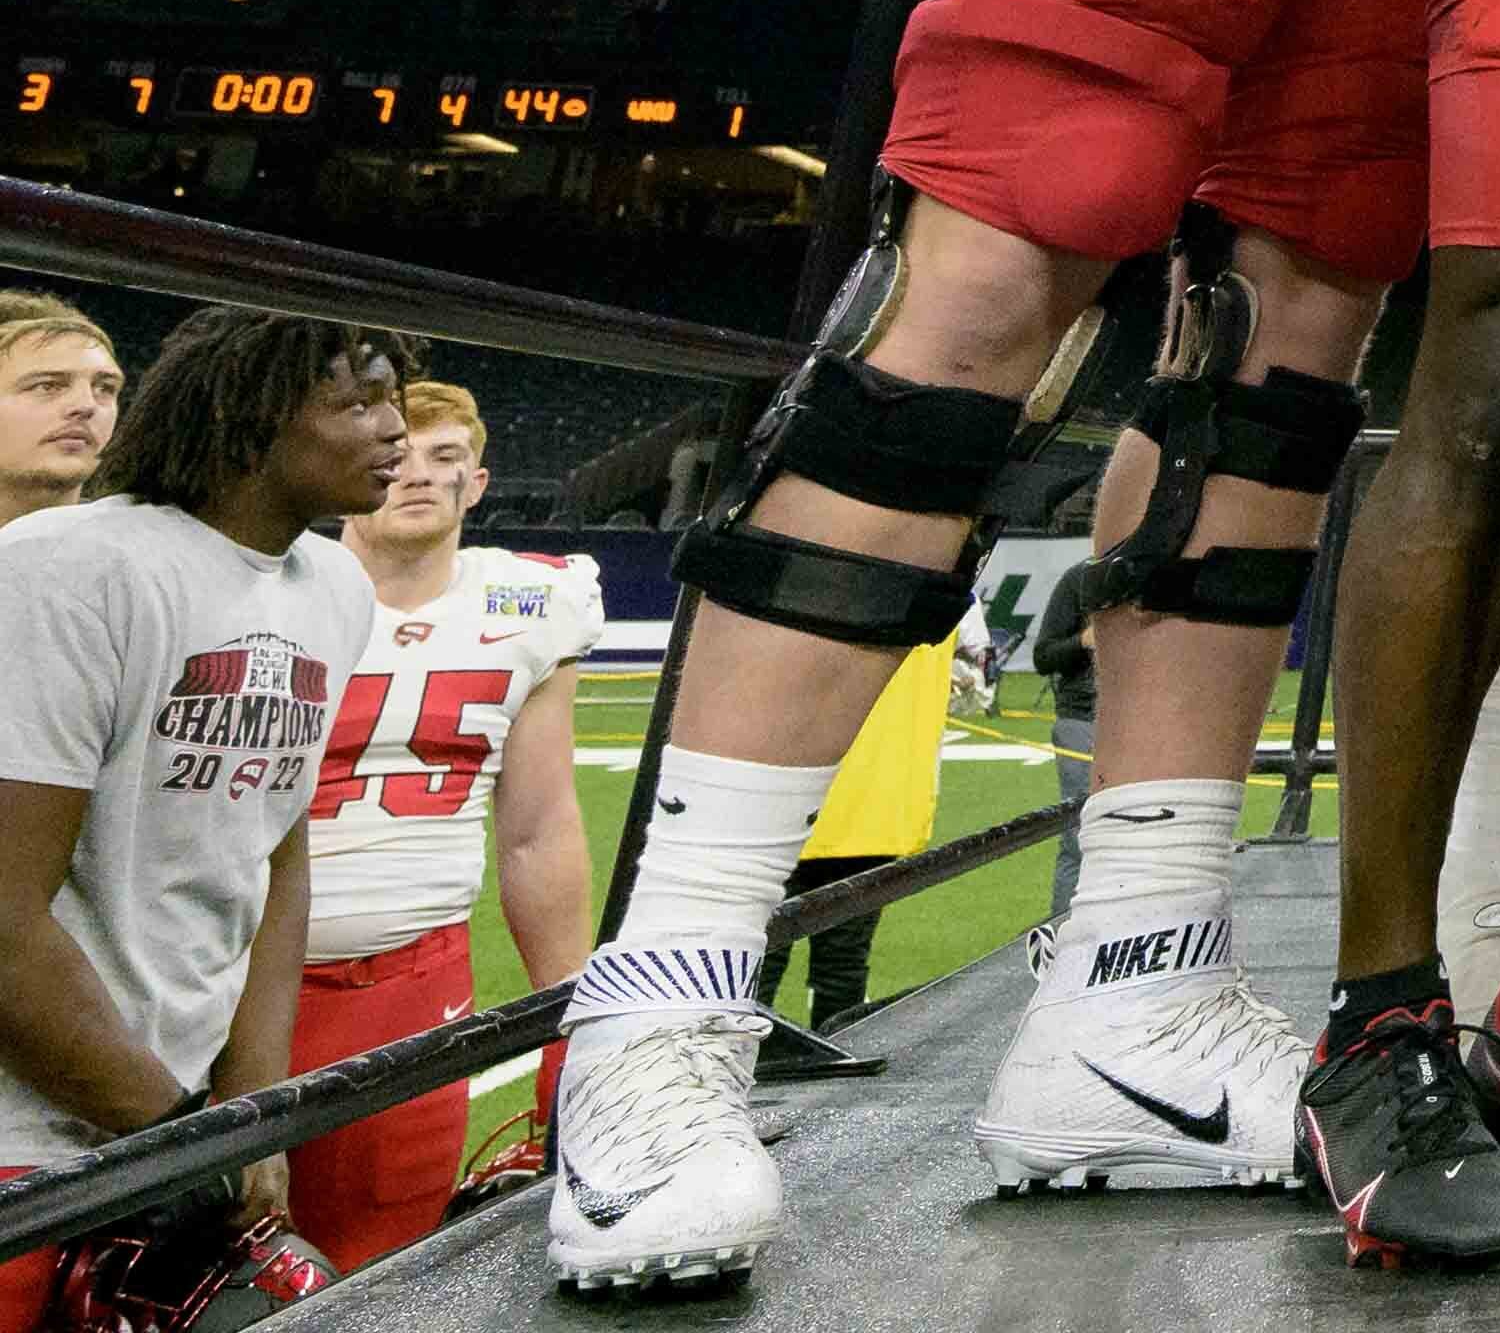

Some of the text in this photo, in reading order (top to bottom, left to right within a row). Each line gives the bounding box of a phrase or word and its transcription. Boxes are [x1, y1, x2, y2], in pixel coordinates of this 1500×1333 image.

[18, 72, 52, 114] 3
[129, 76, 154, 116] 7
[210, 72, 315, 116] 0:00
[371, 88, 397, 125] 7
[440, 93, 468, 127] 4
[154, 694, 328, 751] CHAMPIONS
[159, 751, 224, 793] 20
[266, 754, 306, 794] 22
[1086, 928, 1179, 989] NIKE
